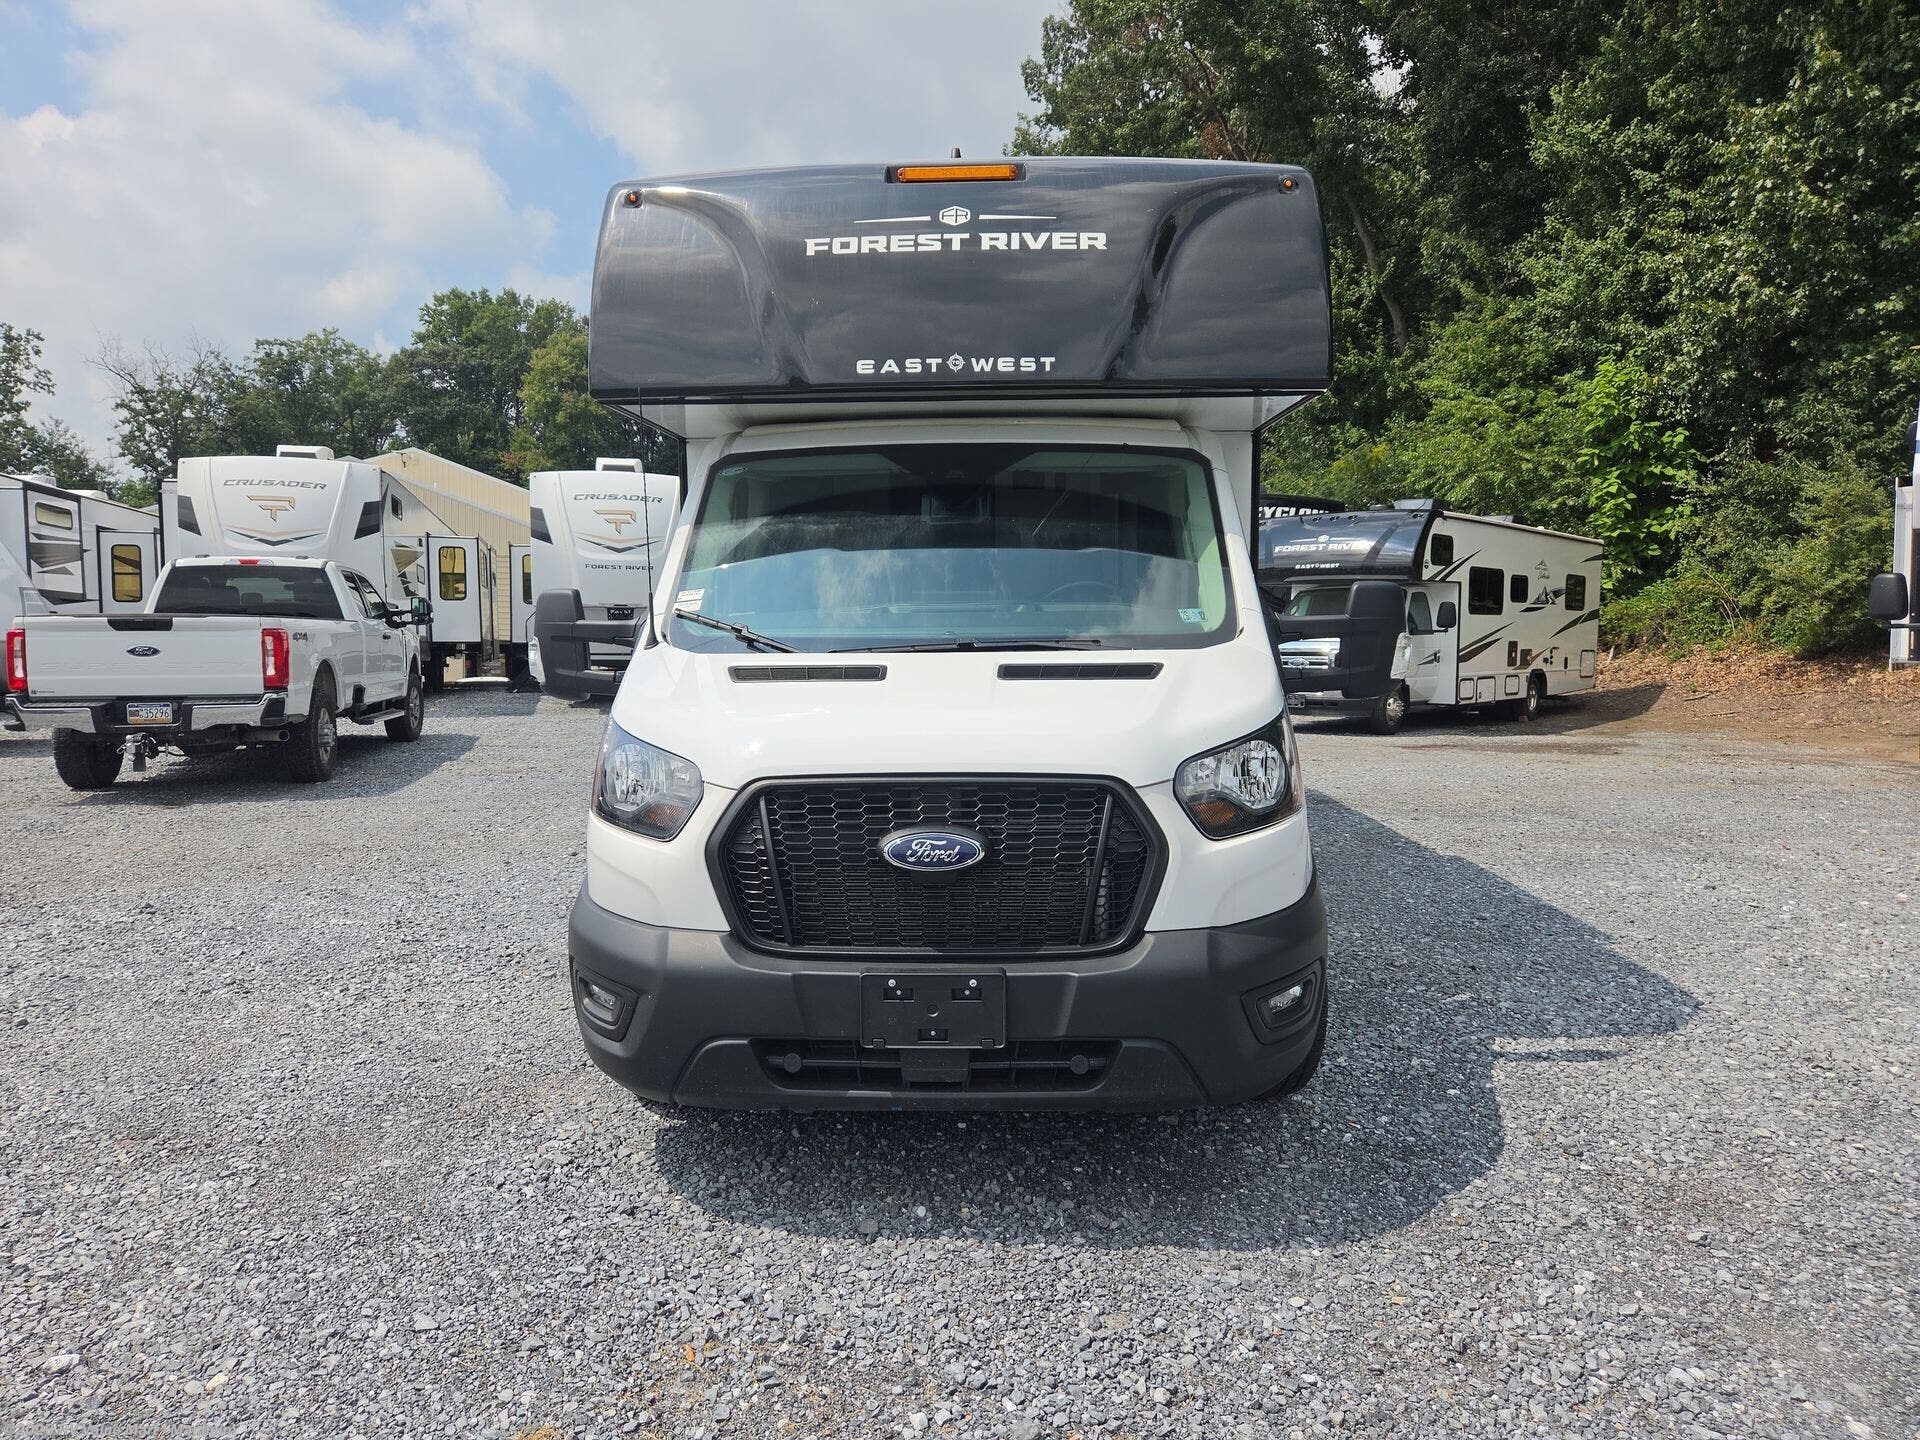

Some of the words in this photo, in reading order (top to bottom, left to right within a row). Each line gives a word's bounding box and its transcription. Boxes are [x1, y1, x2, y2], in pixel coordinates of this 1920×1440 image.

[804, 232, 970, 257] FOREST
[978, 231, 1108, 251] RIVER
[856, 358, 942, 375] EAST
[971, 356, 1056, 373] WEST
[223, 479, 328, 490] CRUSADER
[573, 493, 664, 504] CRUSADER
[1258, 506, 1329, 518] YCLO
[1274, 543, 1327, 554] FOREST
[1328, 543, 1371, 552] RIVER
[585, 563, 622, 571] FOREST
[625, 564, 655, 572] RIVER
[133, 646, 154, 656] Ford
[905, 838, 961, 863] Ford
